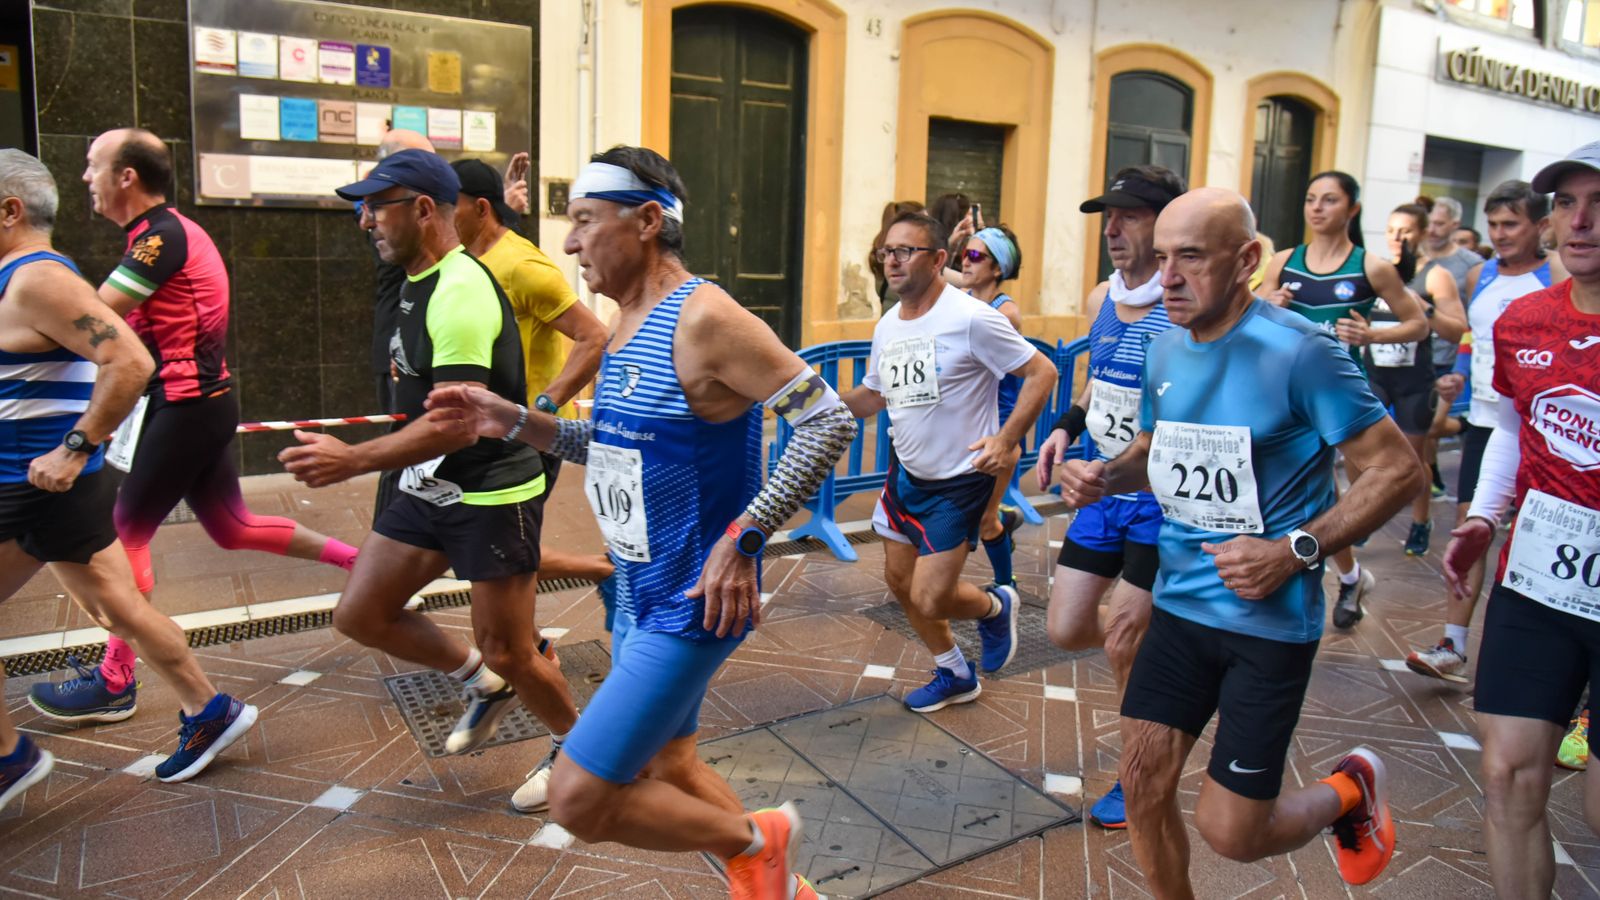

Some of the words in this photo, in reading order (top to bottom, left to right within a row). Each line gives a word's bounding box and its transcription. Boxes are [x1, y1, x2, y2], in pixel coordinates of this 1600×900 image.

[351, 28, 390, 40] PLANTA
[1446, 46, 1524, 94] CLÍNICA
[352, 87, 391, 101] PLANTA
[890, 359, 926, 389] 218
[1104, 412, 1135, 443] 25
[1543, 402, 1600, 436] PONL
[1171, 462, 1239, 504] 220
[593, 482, 632, 525] 109
